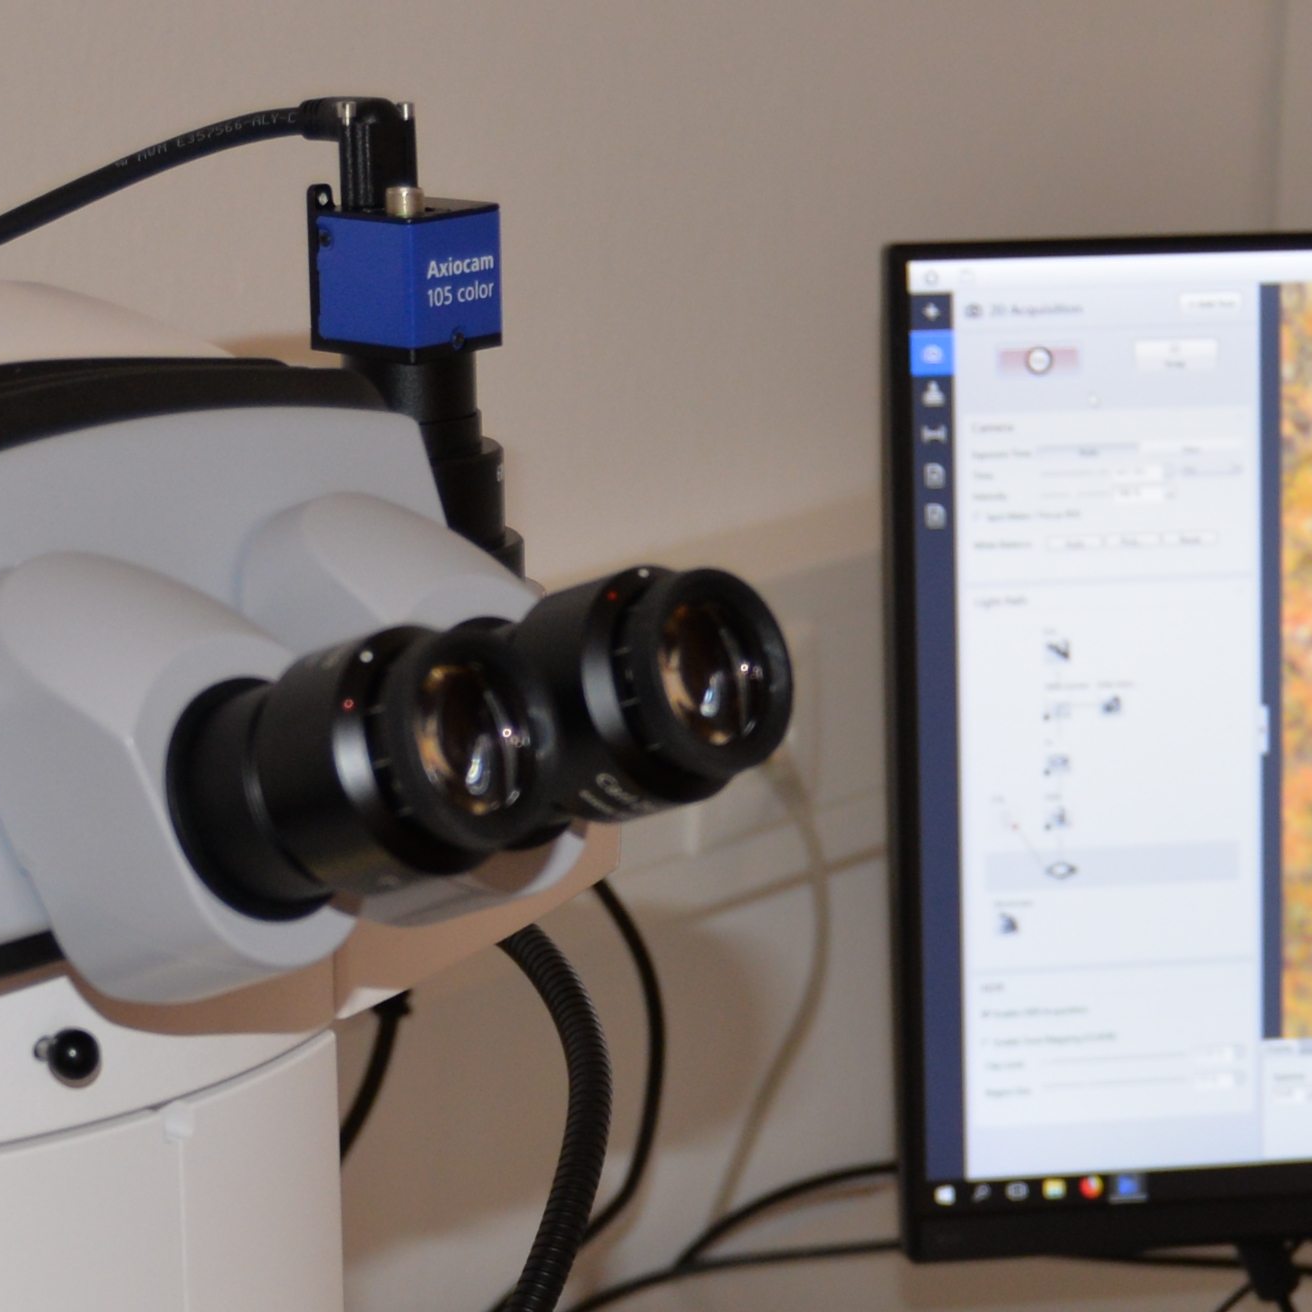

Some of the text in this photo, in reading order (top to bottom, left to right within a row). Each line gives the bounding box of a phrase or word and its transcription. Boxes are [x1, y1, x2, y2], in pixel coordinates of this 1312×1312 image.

[426, 255, 494, 279] Axiocam
[428, 280, 494, 307] 105 color
